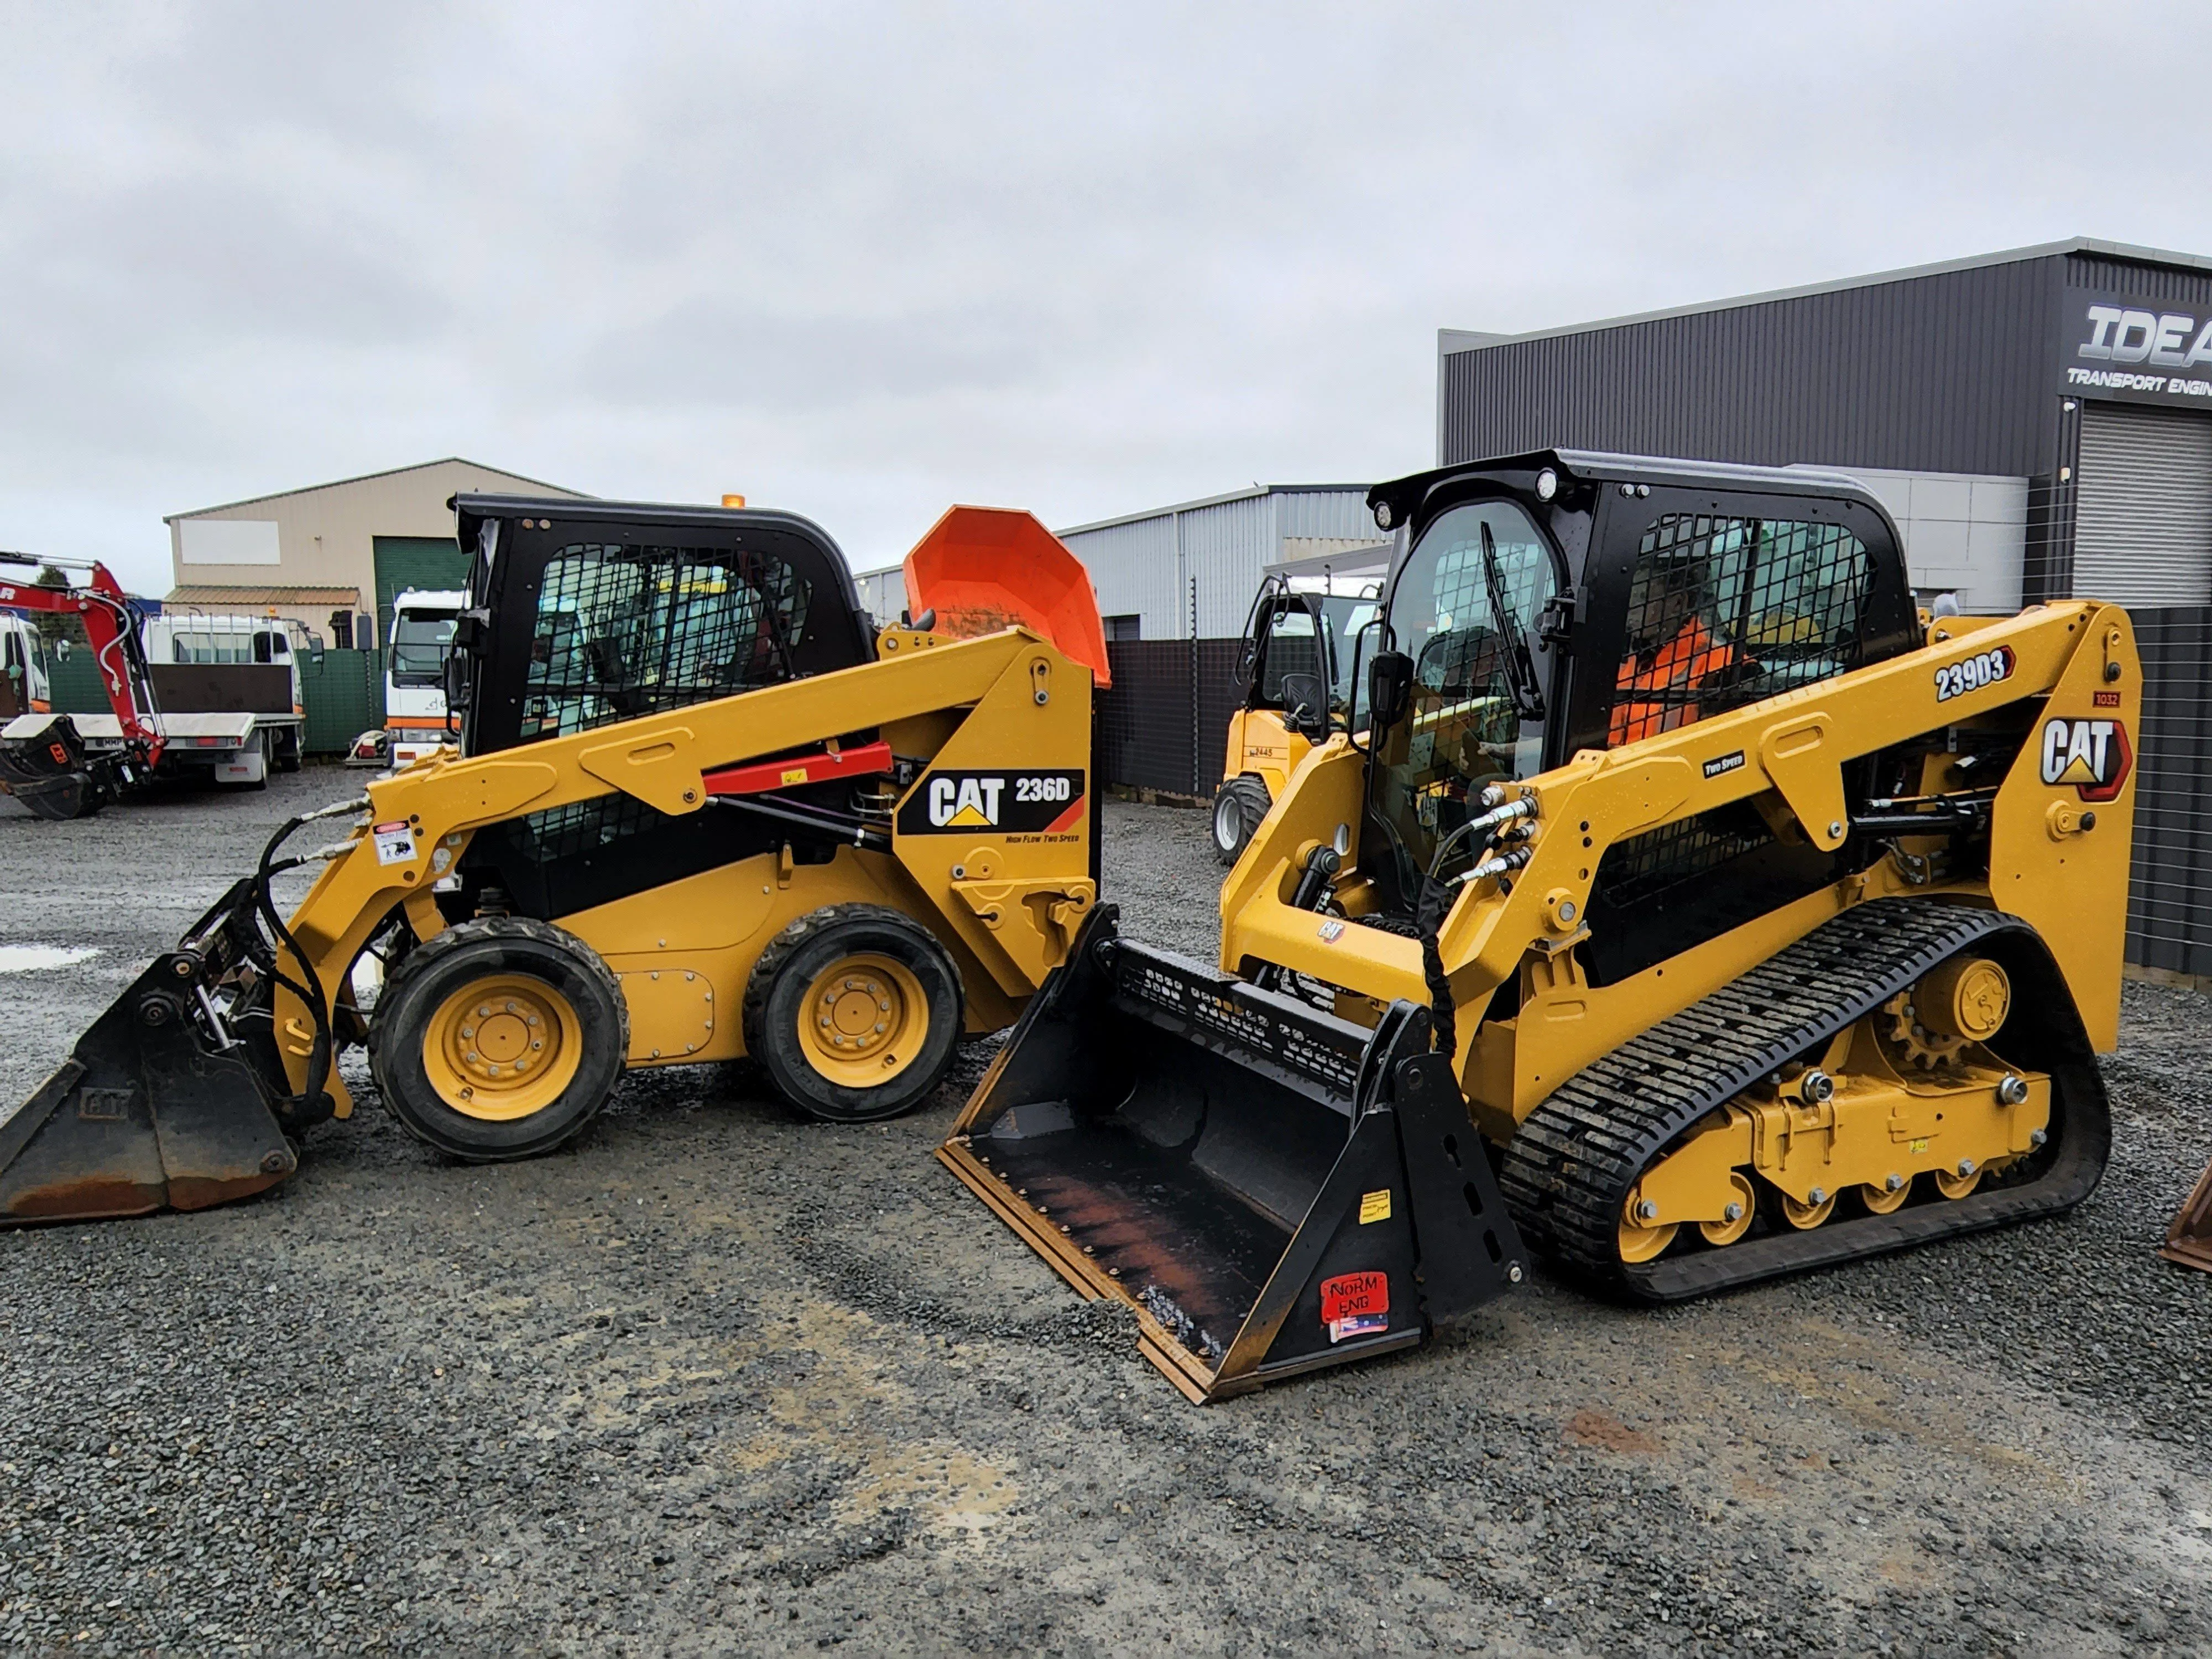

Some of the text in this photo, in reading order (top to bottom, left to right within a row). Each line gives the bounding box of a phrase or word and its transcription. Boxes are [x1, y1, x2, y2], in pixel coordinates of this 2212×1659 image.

[2078, 305, 2212, 368] IDEA
[2067, 367, 2167, 392] TRANSPORT
[1936, 649, 2005, 701] 239D3
[2096, 693, 2118, 706] 1032
[2042, 719, 2114, 783] CAT
[929, 777, 1070, 827] CAT 236D
[1318, 921, 1344, 940] CAT
[1330, 1276, 1377, 1298] NORM
[1339, 1295, 1369, 1314] ENG
